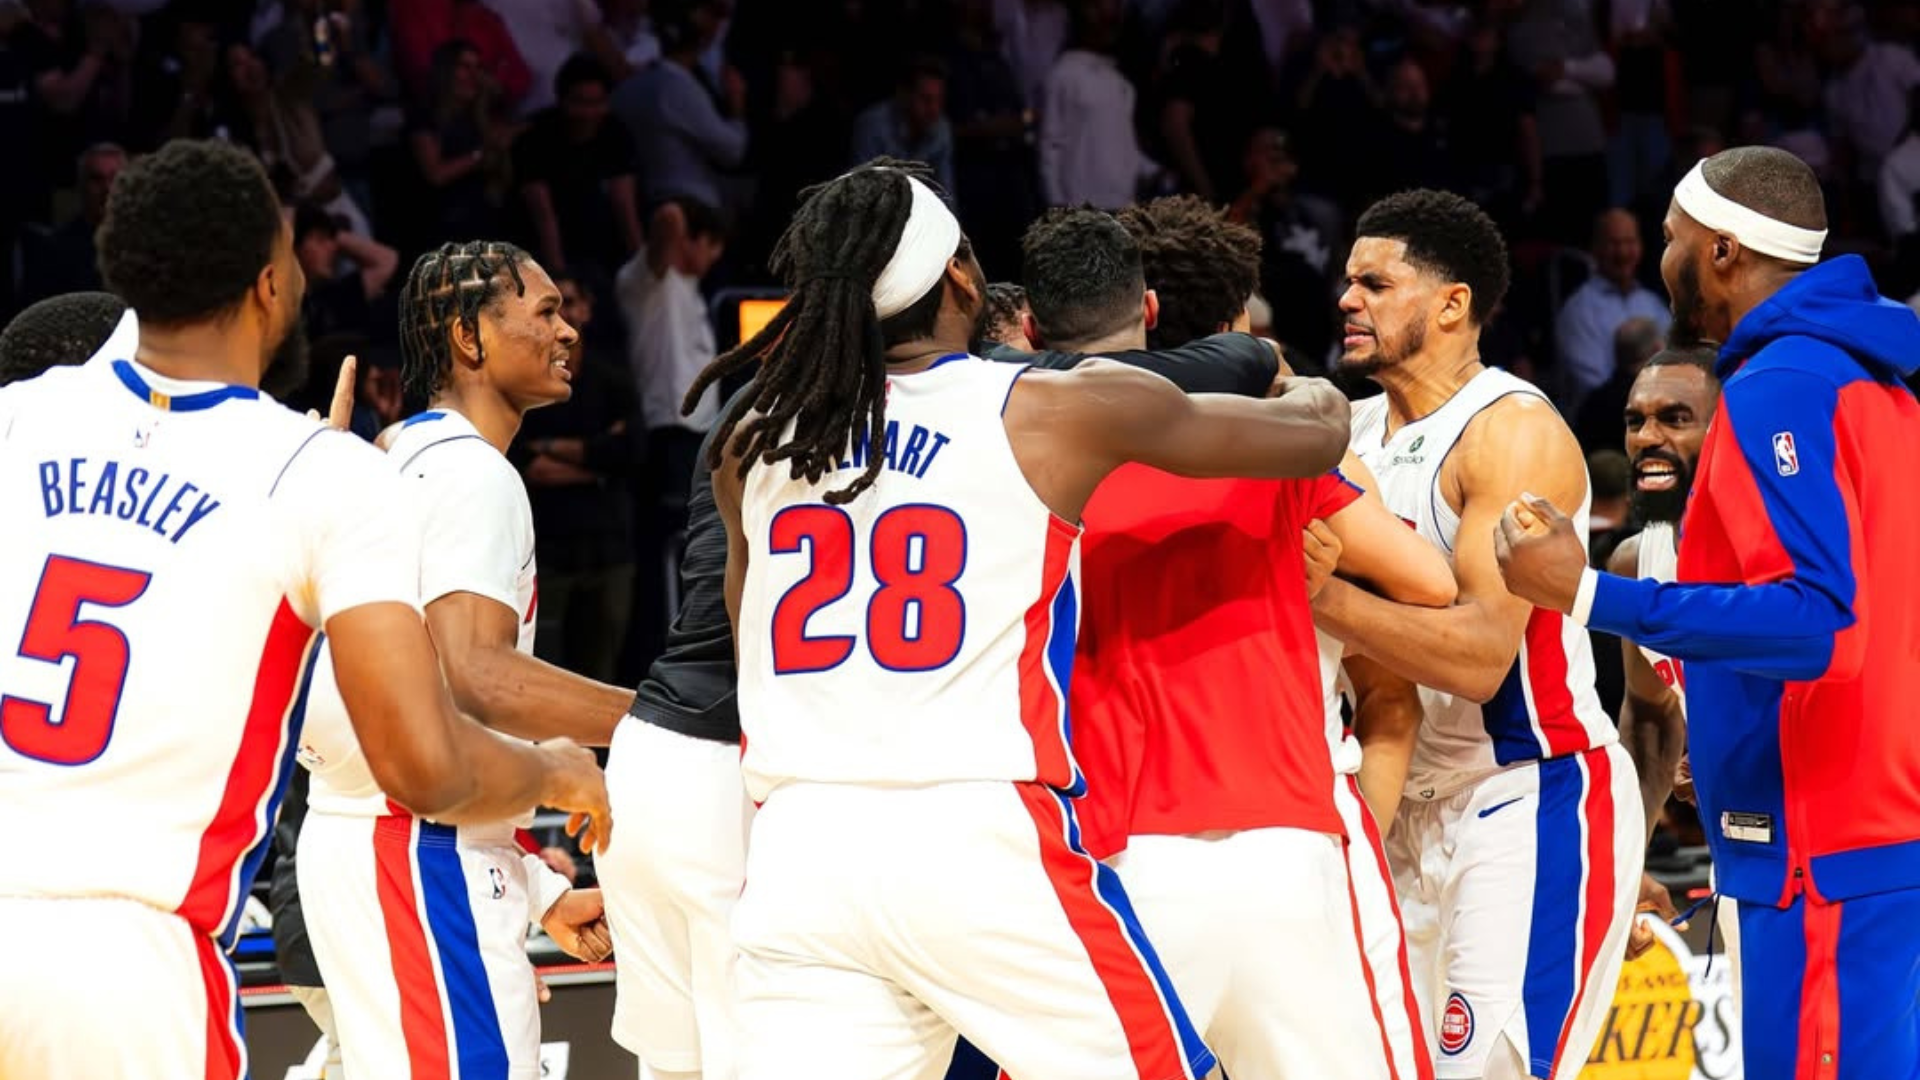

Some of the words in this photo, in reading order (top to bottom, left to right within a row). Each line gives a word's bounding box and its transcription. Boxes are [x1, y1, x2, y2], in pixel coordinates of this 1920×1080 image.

[39, 457, 221, 544] BEASLEY
[769, 502, 968, 676] 28
[0, 552, 154, 767] 5
[1587, 995, 1734, 1080] KERS
